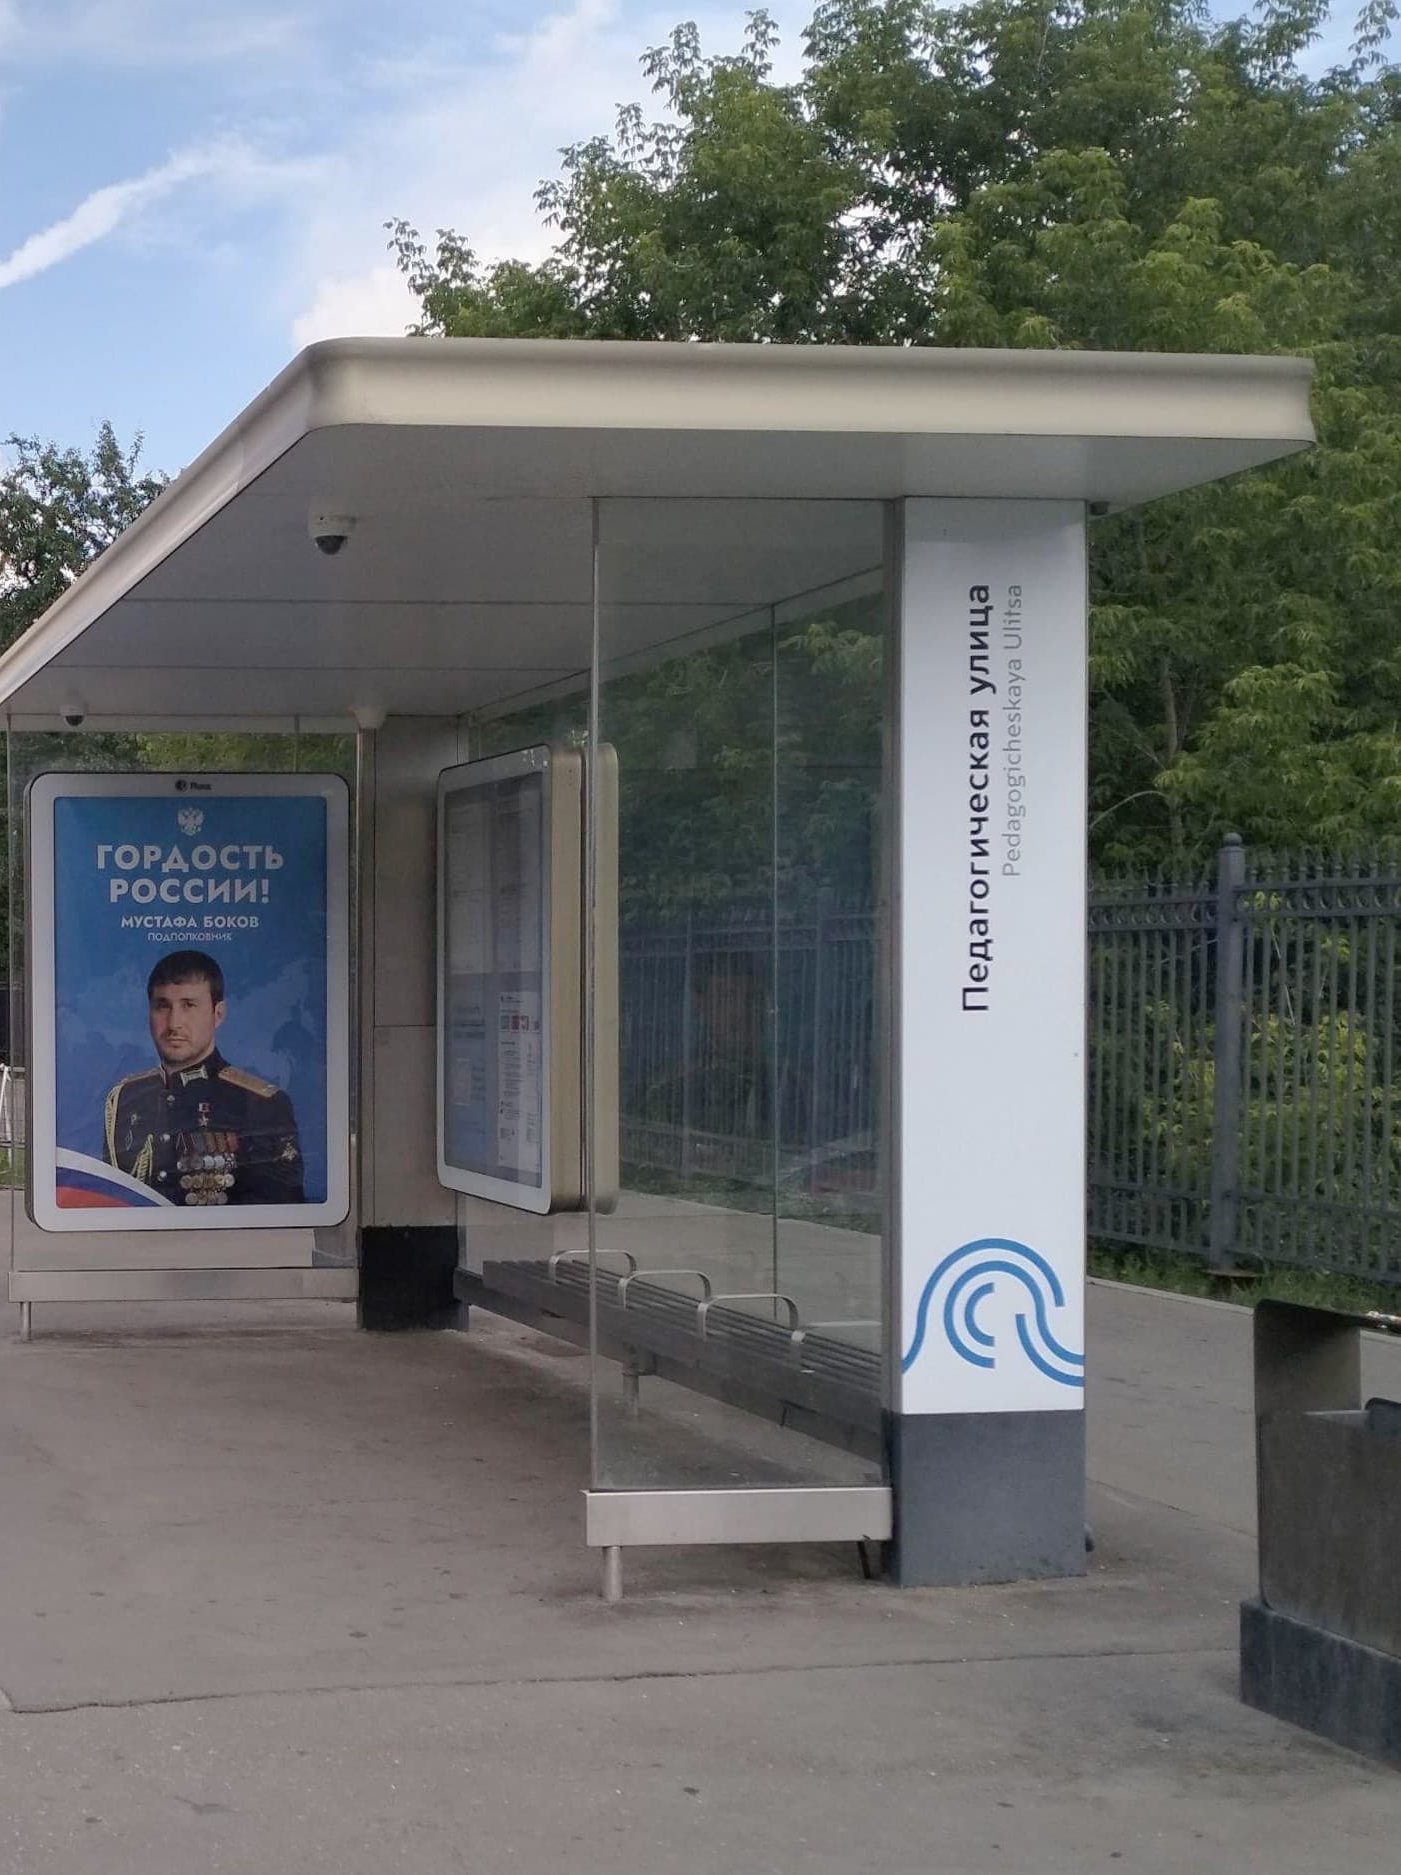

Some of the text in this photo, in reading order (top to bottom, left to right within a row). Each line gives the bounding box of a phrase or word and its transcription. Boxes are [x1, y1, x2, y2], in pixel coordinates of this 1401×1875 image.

[1001, 584, 1027, 877] Pedagogicheskaya Ulitsa
[962, 584, 996, 1011] Педагогическая улица
[97, 844, 284, 873] ГОРДОСТЬ
[110, 878, 270, 904] РОССИИ!
[121, 915, 260, 929] МУСТАФА БОКОВ
[147, 932, 232, 942] ПОДПОЛКОВНИК
